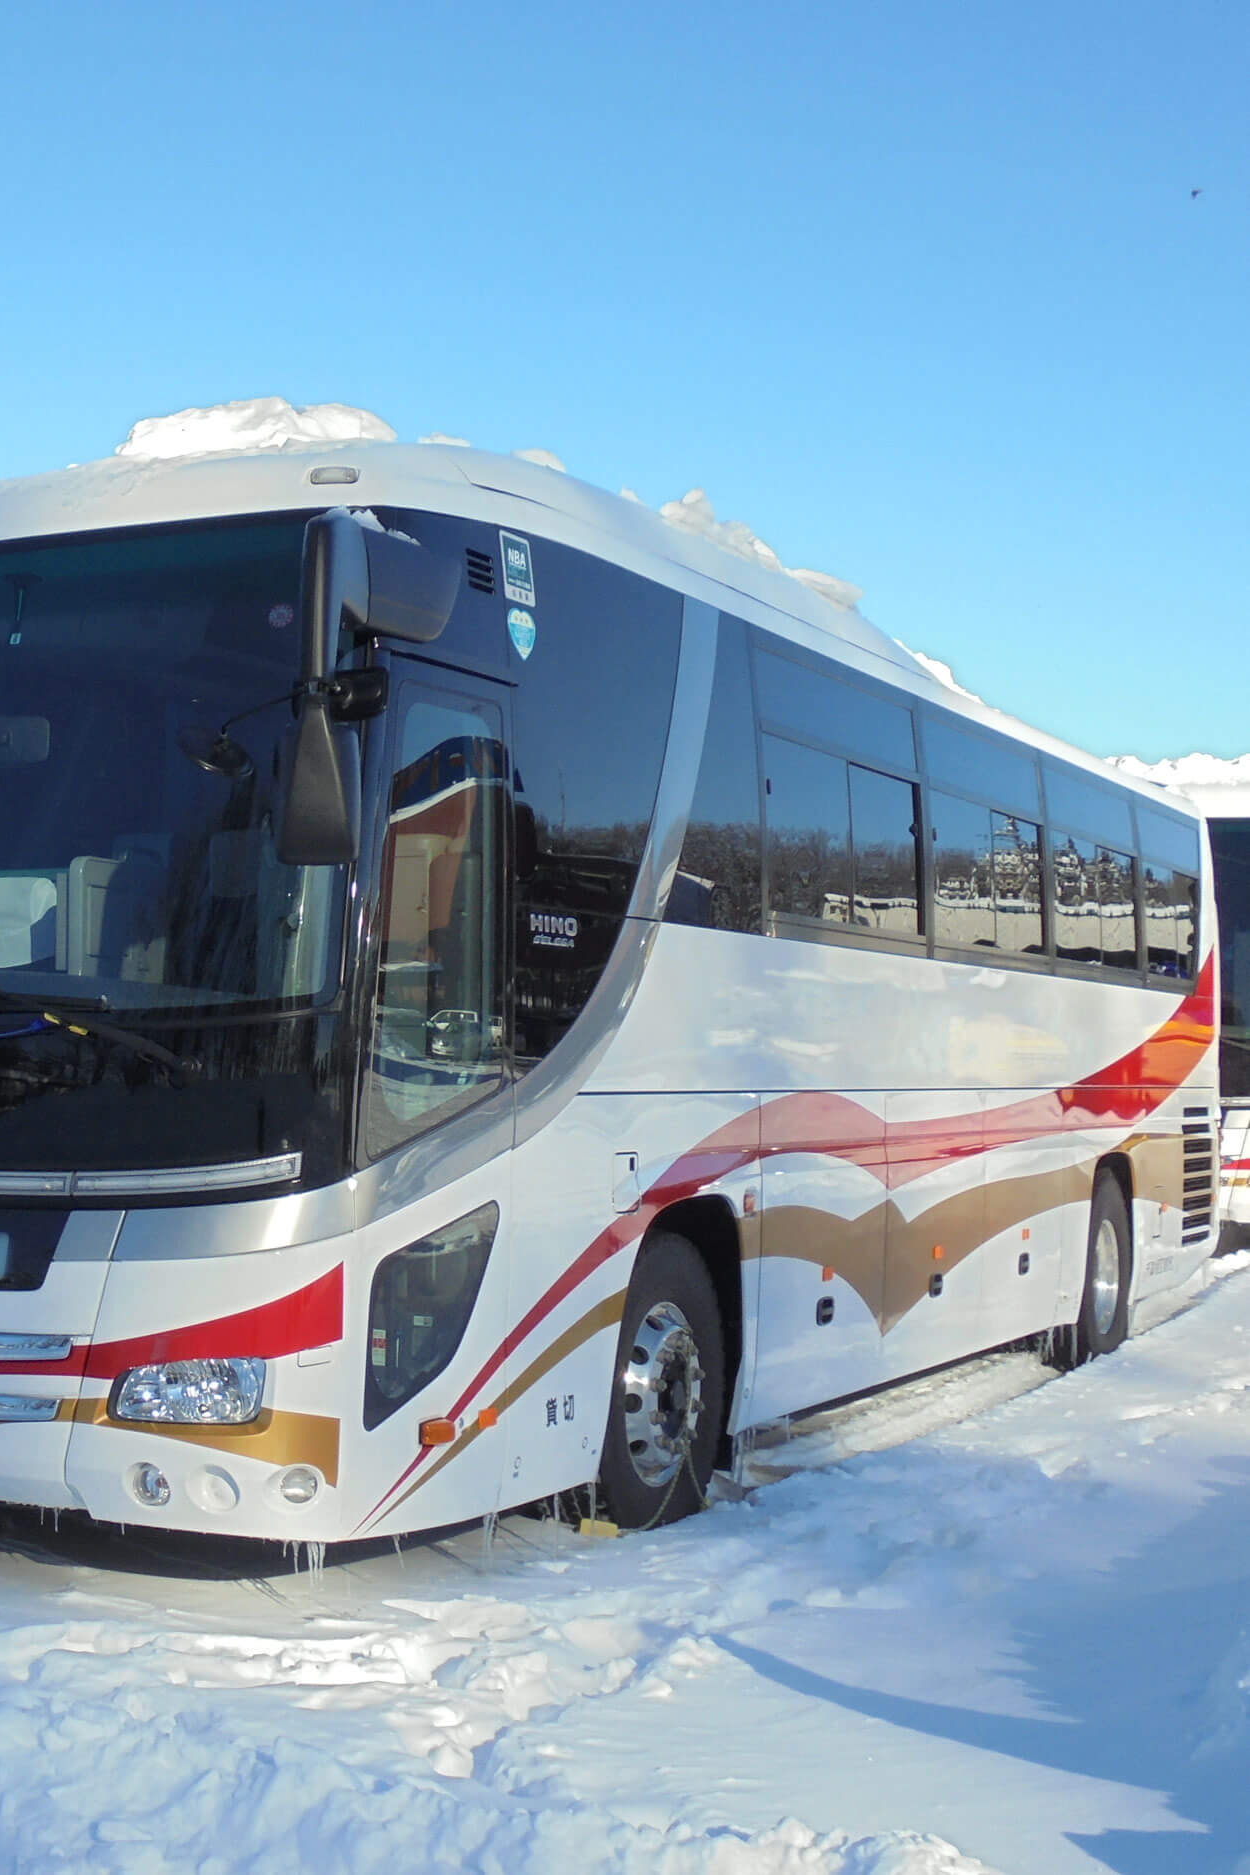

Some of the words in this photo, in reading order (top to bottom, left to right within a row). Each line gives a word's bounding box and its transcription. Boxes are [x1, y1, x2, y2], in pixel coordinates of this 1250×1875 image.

[507, 547, 527, 568] NBA
[529, 913, 578, 937] HINO
[545, 1394, 575, 1427] 貸切
